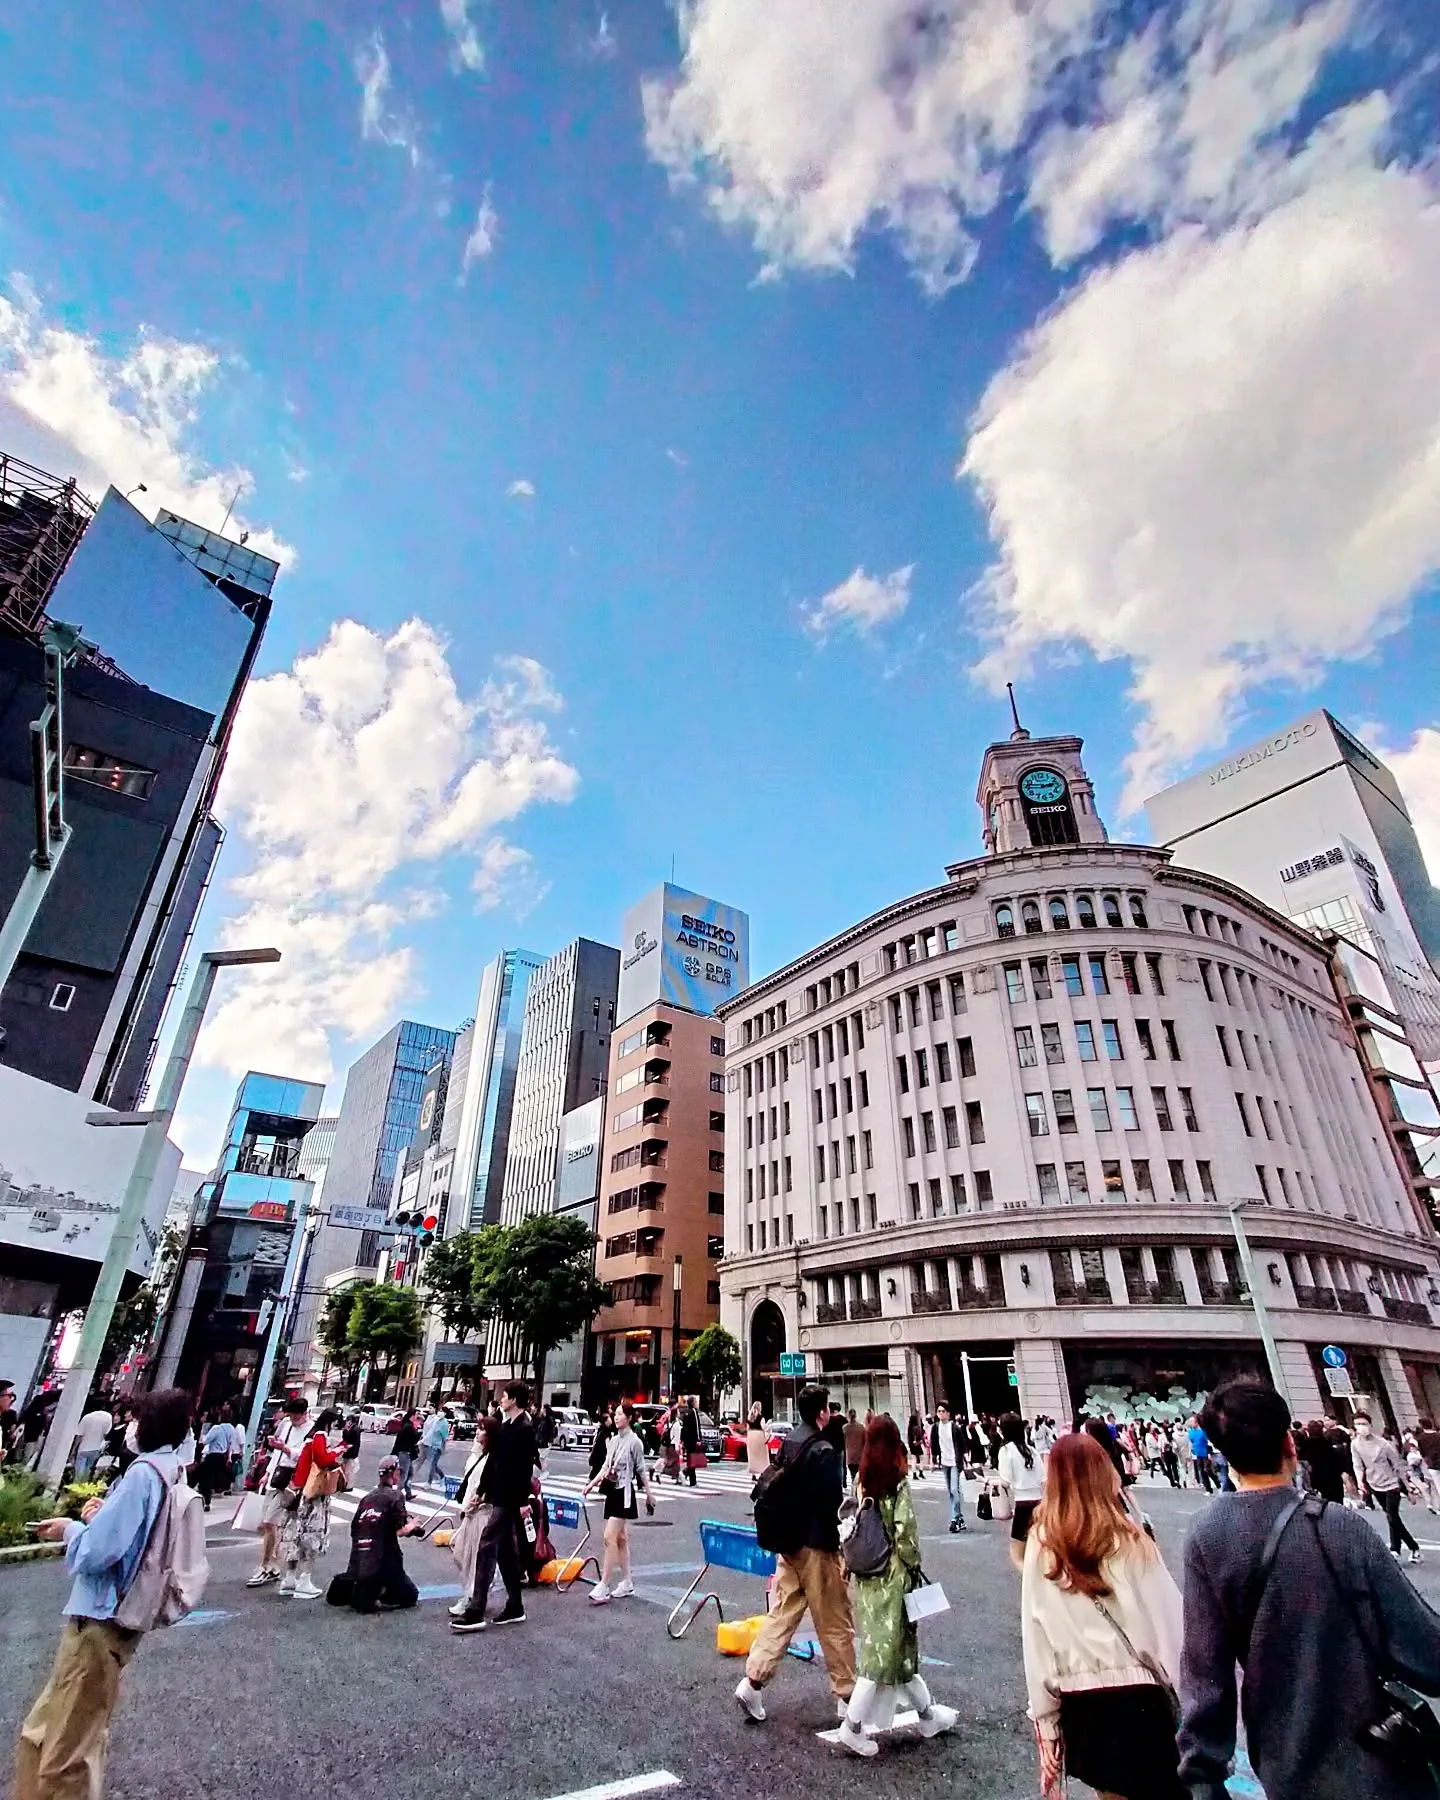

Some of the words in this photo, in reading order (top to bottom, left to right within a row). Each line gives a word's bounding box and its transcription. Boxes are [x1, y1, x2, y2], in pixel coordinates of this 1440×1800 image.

[1209, 723, 1318, 786] MIKIMOTO
[1030, 805, 1067, 814] SEIKO
[1280, 847, 1344, 883] 山野楽器
[681, 914, 736, 944] SEIKO
[676, 930, 739, 962] ASTRON
[705, 962, 732, 979] GPS
[705, 973, 731, 986] SOLAR
